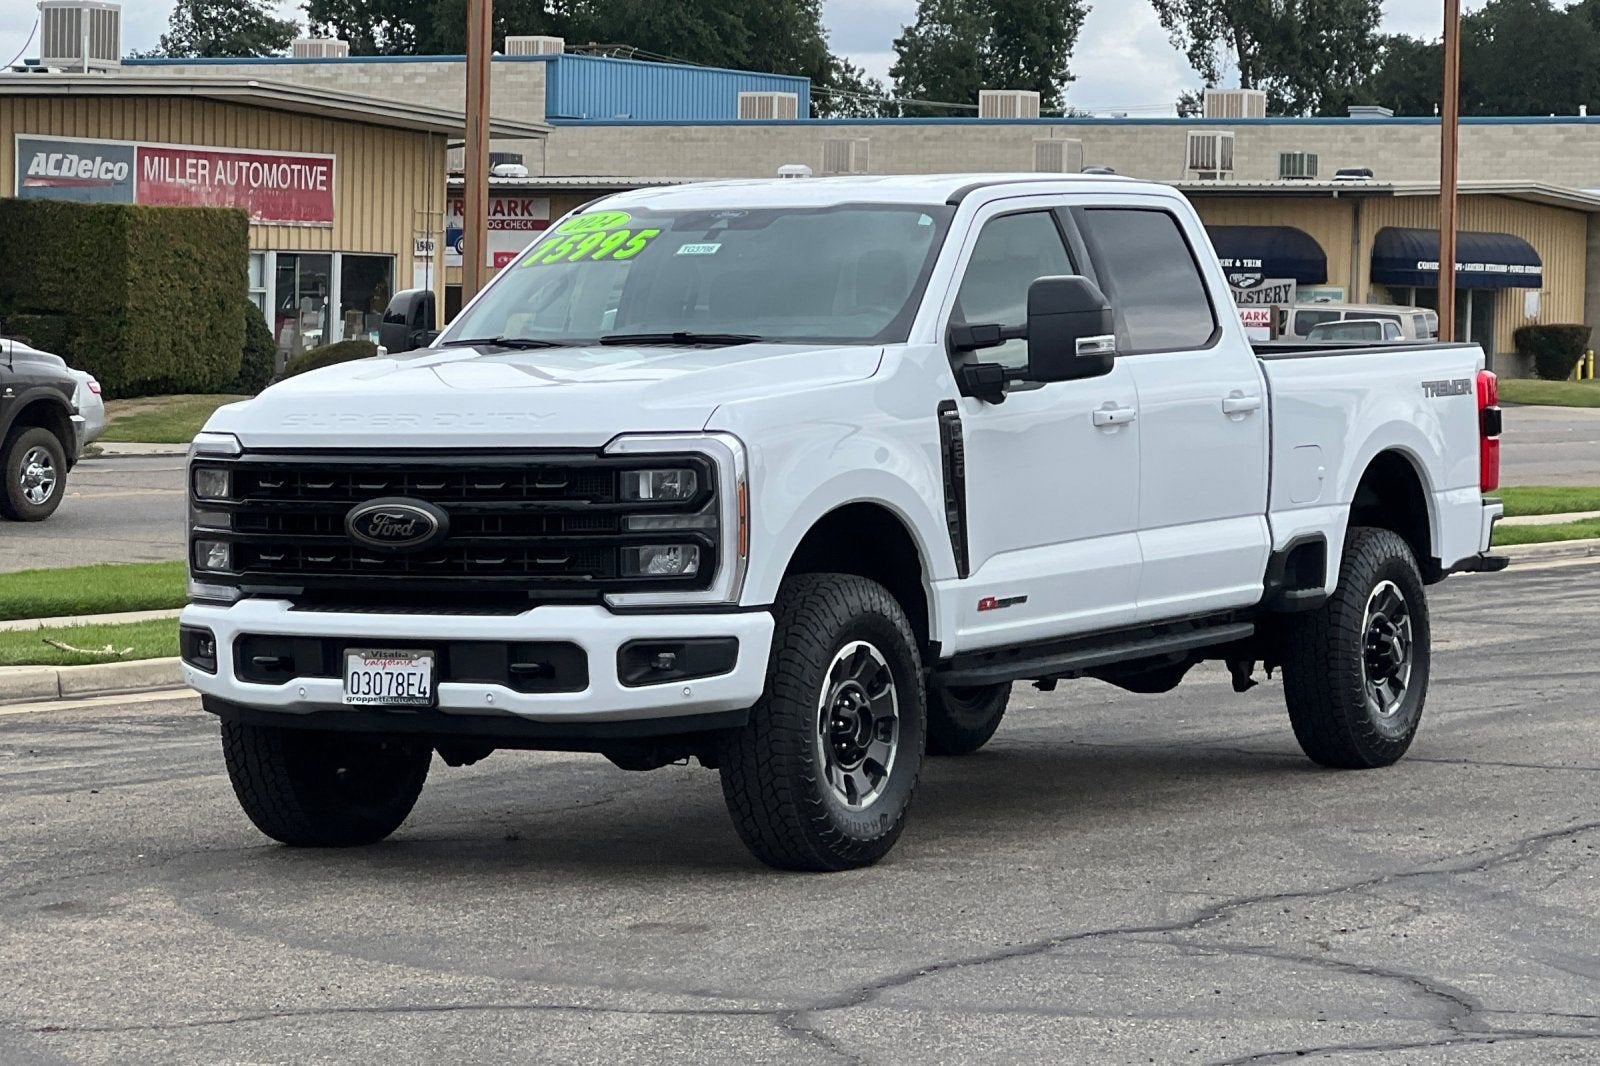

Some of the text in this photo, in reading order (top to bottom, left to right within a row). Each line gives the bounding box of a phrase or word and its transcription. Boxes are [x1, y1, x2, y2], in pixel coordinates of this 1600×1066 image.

[27, 152, 129, 181] ACDelco
[144, 156, 327, 191] MILLER AUTOMOTIVE
[504, 220, 533, 229] CHECK
[522, 229, 660, 268] 75995
[1243, 259, 1262, 268] TRIM
[1421, 379, 1472, 398] TREMOR
[281, 411, 557, 428] SUPER DUTY
[368, 512, 416, 536] Ford
[371, 650, 409, 658] Visalia
[363, 658, 414, 670] California
[350, 671, 428, 697] 03078E4
